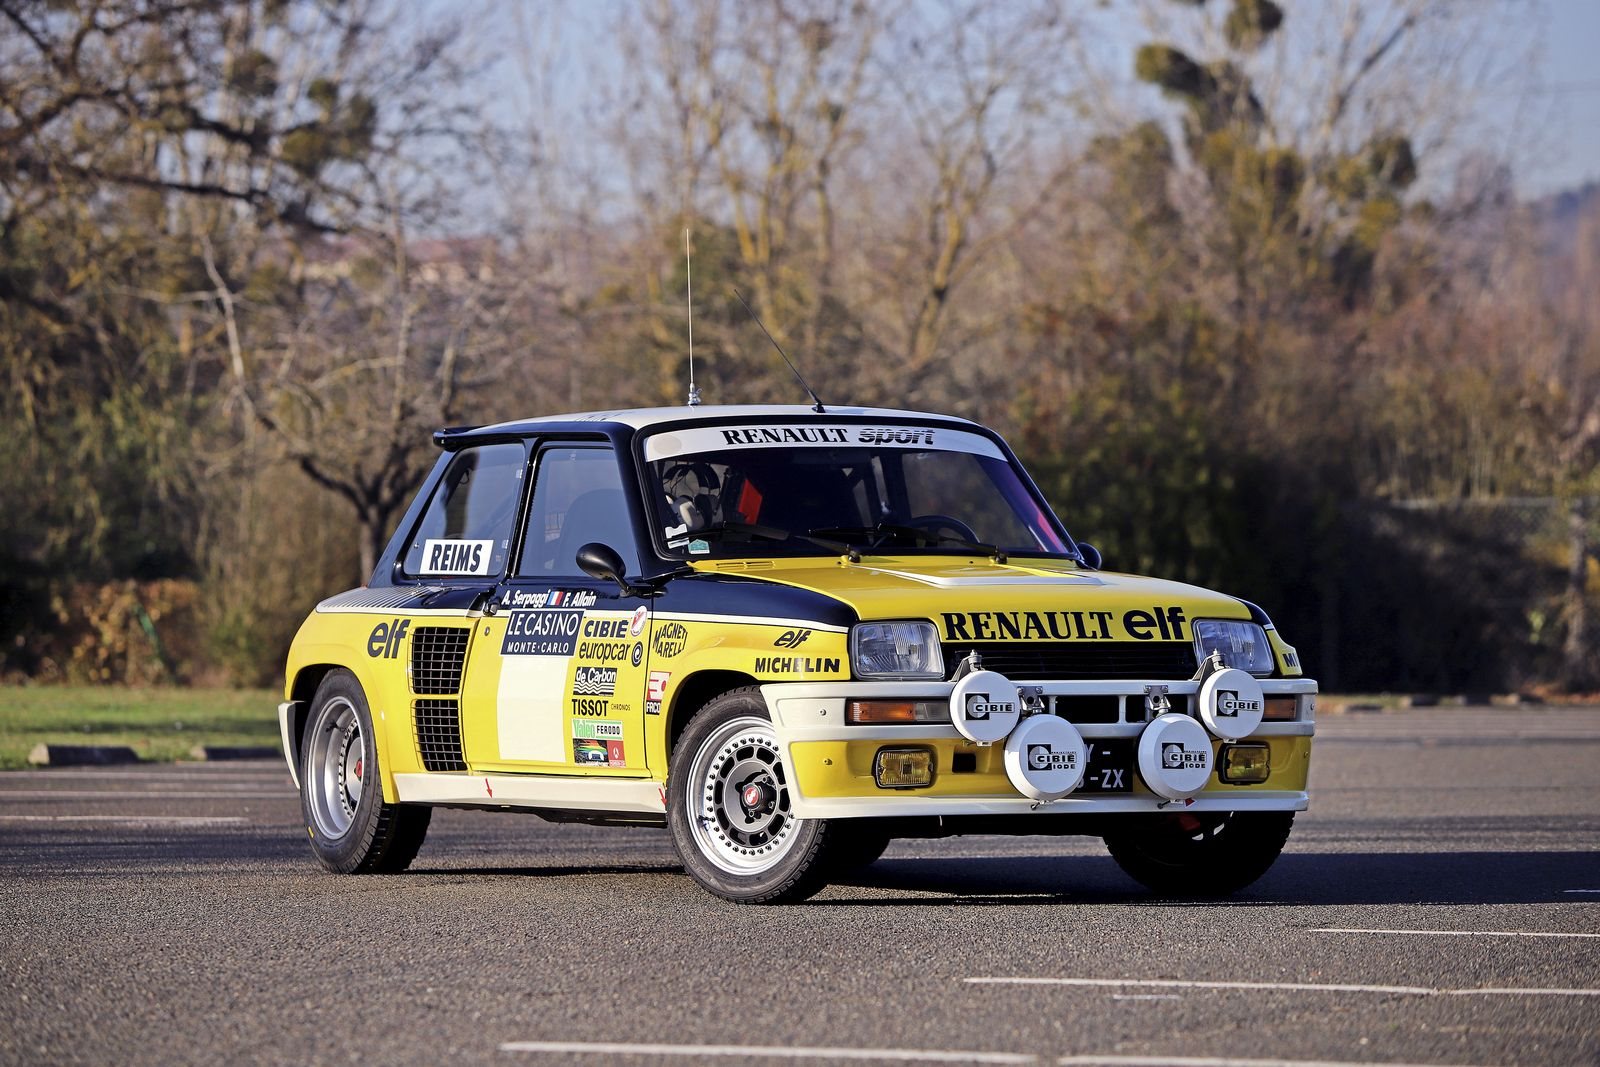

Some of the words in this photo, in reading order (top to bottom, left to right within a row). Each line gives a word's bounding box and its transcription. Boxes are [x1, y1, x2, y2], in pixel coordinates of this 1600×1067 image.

[720, 428, 850, 446] RENAULT
[858, 428, 936, 446] sport
[429, 544, 482, 572] REIMS
[501, 590, 510, 605] A.
[512, 589, 551, 608] Serpaggi
[562, 592, 571, 607] F.
[571, 591, 597, 607] Allain
[507, 613, 525, 636] LE
[524, 613, 579, 636] CASINO
[584, 620, 629, 638] CIBIÉ
[940, 611, 1113, 640] RENAULT
[1122, 606, 1186, 640] elf
[367, 619, 411, 659] elf
[773, 629, 812, 649] elf
[579, 642, 631, 665] europcar
[754, 657, 840, 673] MICHELIN
[576, 668, 586, 683] de
[588, 668, 616, 684] Carbon
[572, 699, 608, 716] TISSOT
[573, 720, 595, 738] Valeo
[596, 725, 620, 735] FERODO
